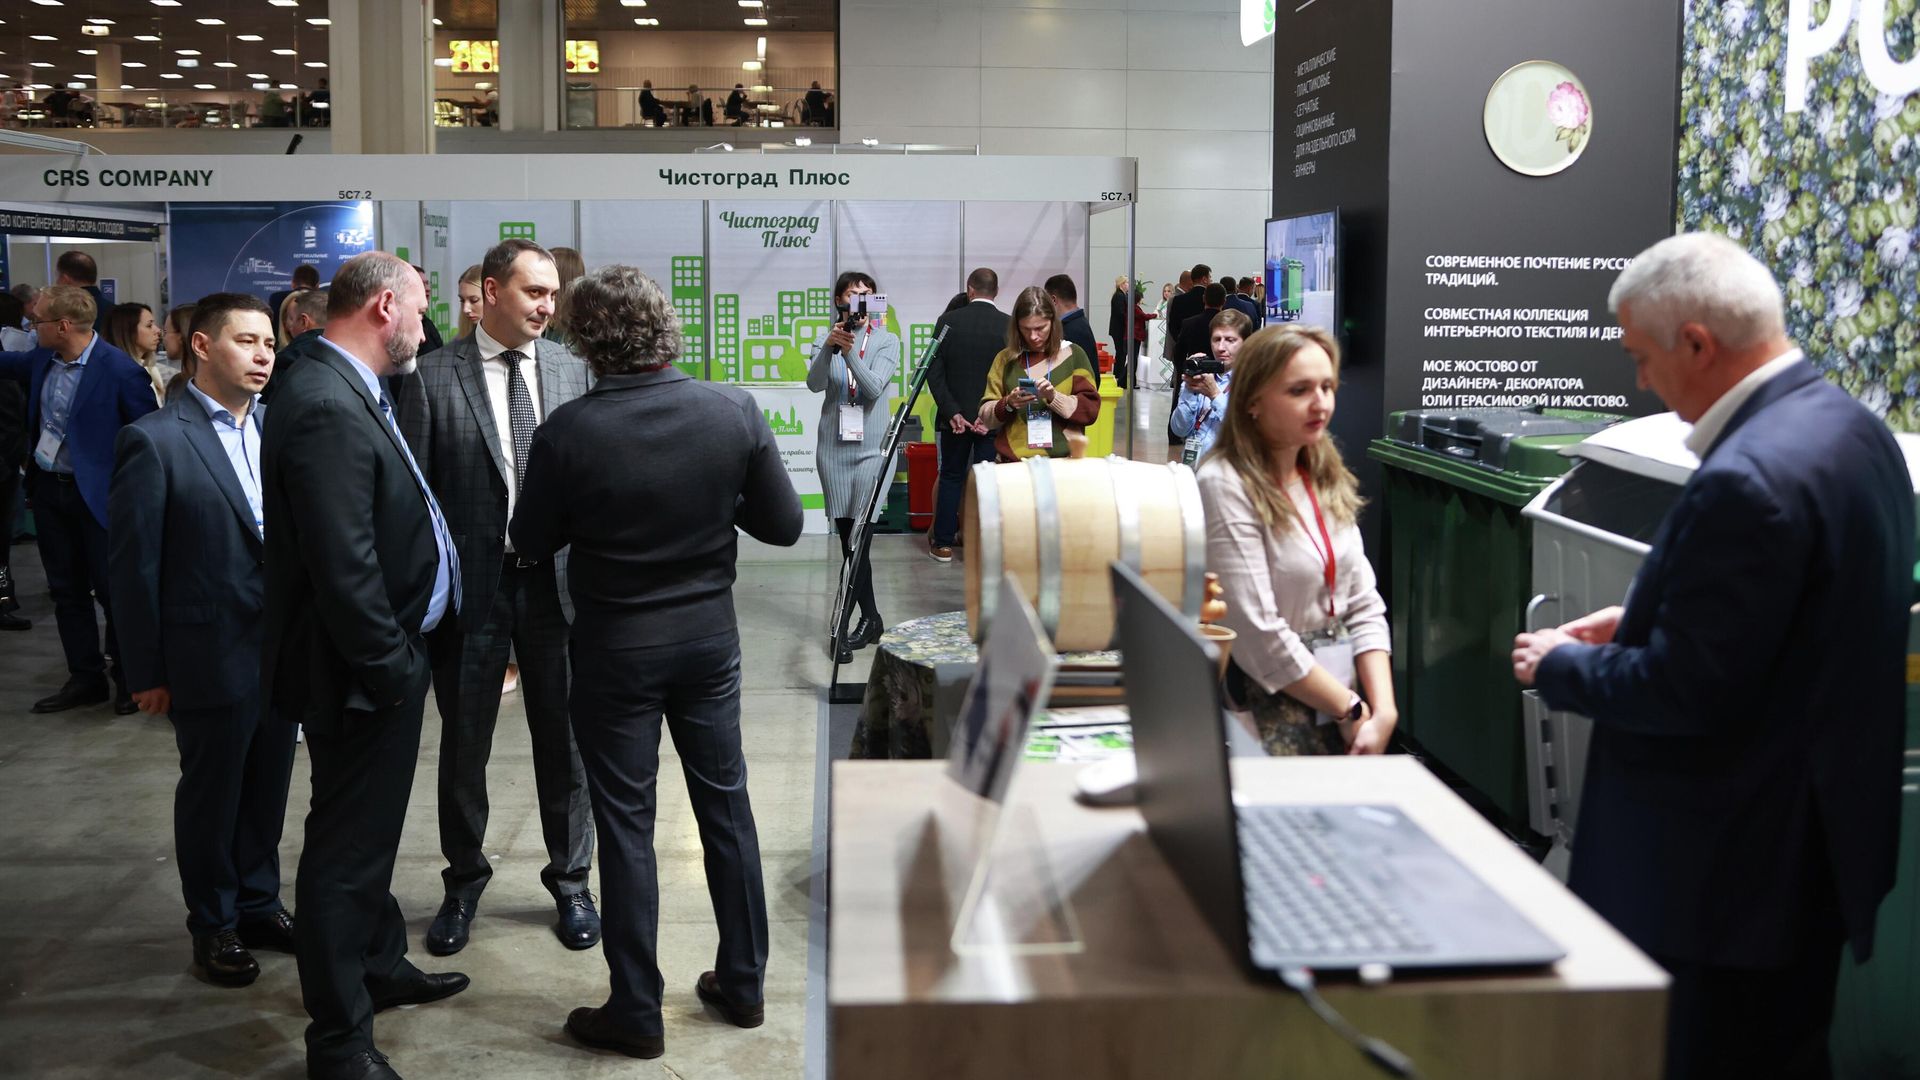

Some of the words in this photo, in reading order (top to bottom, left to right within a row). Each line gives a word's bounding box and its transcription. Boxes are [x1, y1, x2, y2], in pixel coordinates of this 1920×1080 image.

[43, 169, 90, 187] CRS
[99, 169, 214, 187] COMPANY
[659, 168, 778, 189] Чистоград
[789, 168, 850, 186] Плюс
[338, 190, 372, 200] 5C7.2
[1101, 191, 1132, 201] 5C7.1
[12, 213, 61, 230] КОНТЕЙНЕРОВ
[62, 218, 76, 232] ДЛЯ
[76, 220, 97, 233] СБОРА
[97, 221, 125, 235] ОТХОДОВ
[719, 211, 819, 233] Чистоград
[761, 231, 812, 248] Плюс
[1425, 256, 1521, 269] СОВРЕМЕННОЕ
[1523, 256, 1591, 270] ПОЧТЕНИЕ
[1592, 257, 1635, 270] РУССК
[1425, 271, 1499, 287] ТРАДИЦИЙ.
[1424, 308, 1511, 321] СОВМЕСТНАЯ
[1513, 308, 1589, 323] КОЛЛЕКЦИЯ
[1424, 326, 1522, 338] ИНТЕРЬЕРНОГО
[1524, 326, 1587, 339] ТЕКСТИЛЯ
[1589, 327, 1600, 339] И
[1423, 360, 1452, 372] МОЕ
[1454, 360, 1518, 372] ЖОСТОВО
[1520, 360, 1538, 372] ОТ
[1422, 375, 1502, 391] ДИЗАЙНЕРА-
[1504, 377, 1584, 392] ДЕКОРАТОРА
[1422, 395, 1453, 407] ЮЛИ
[1550, 395, 1561, 407] И
[1562, 395, 1629, 408] ЖОСТОВО.
